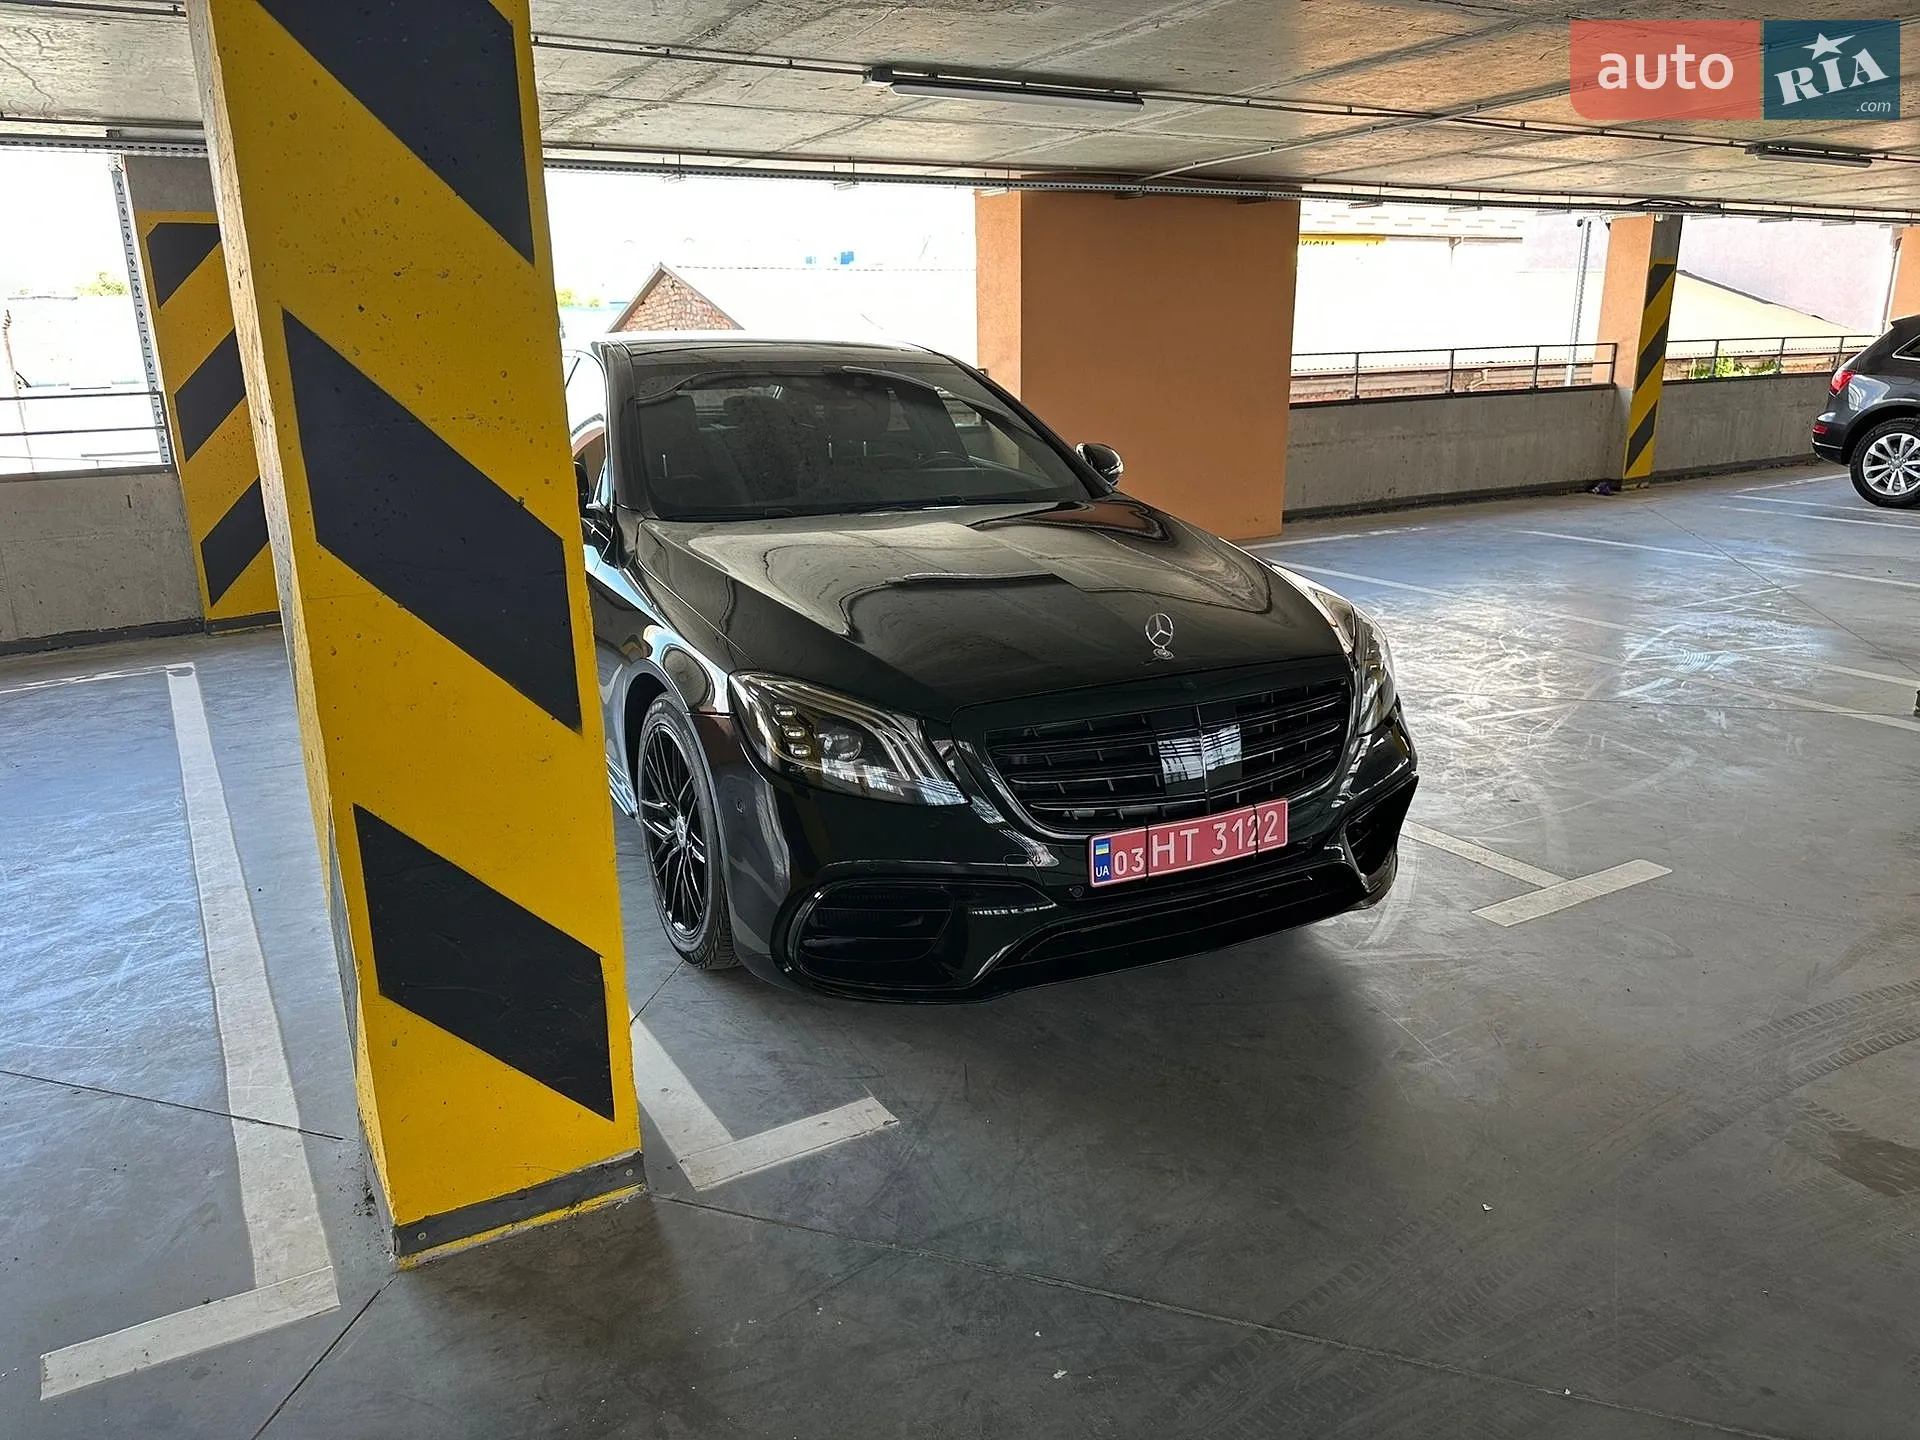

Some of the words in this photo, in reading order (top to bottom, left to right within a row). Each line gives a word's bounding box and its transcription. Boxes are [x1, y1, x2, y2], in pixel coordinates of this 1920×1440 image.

[1095, 864, 1110, 877] UA
[1113, 847, 1144, 875] 03
[1152, 828, 1200, 867] HT
[1211, 810, 1278, 855] 3122
